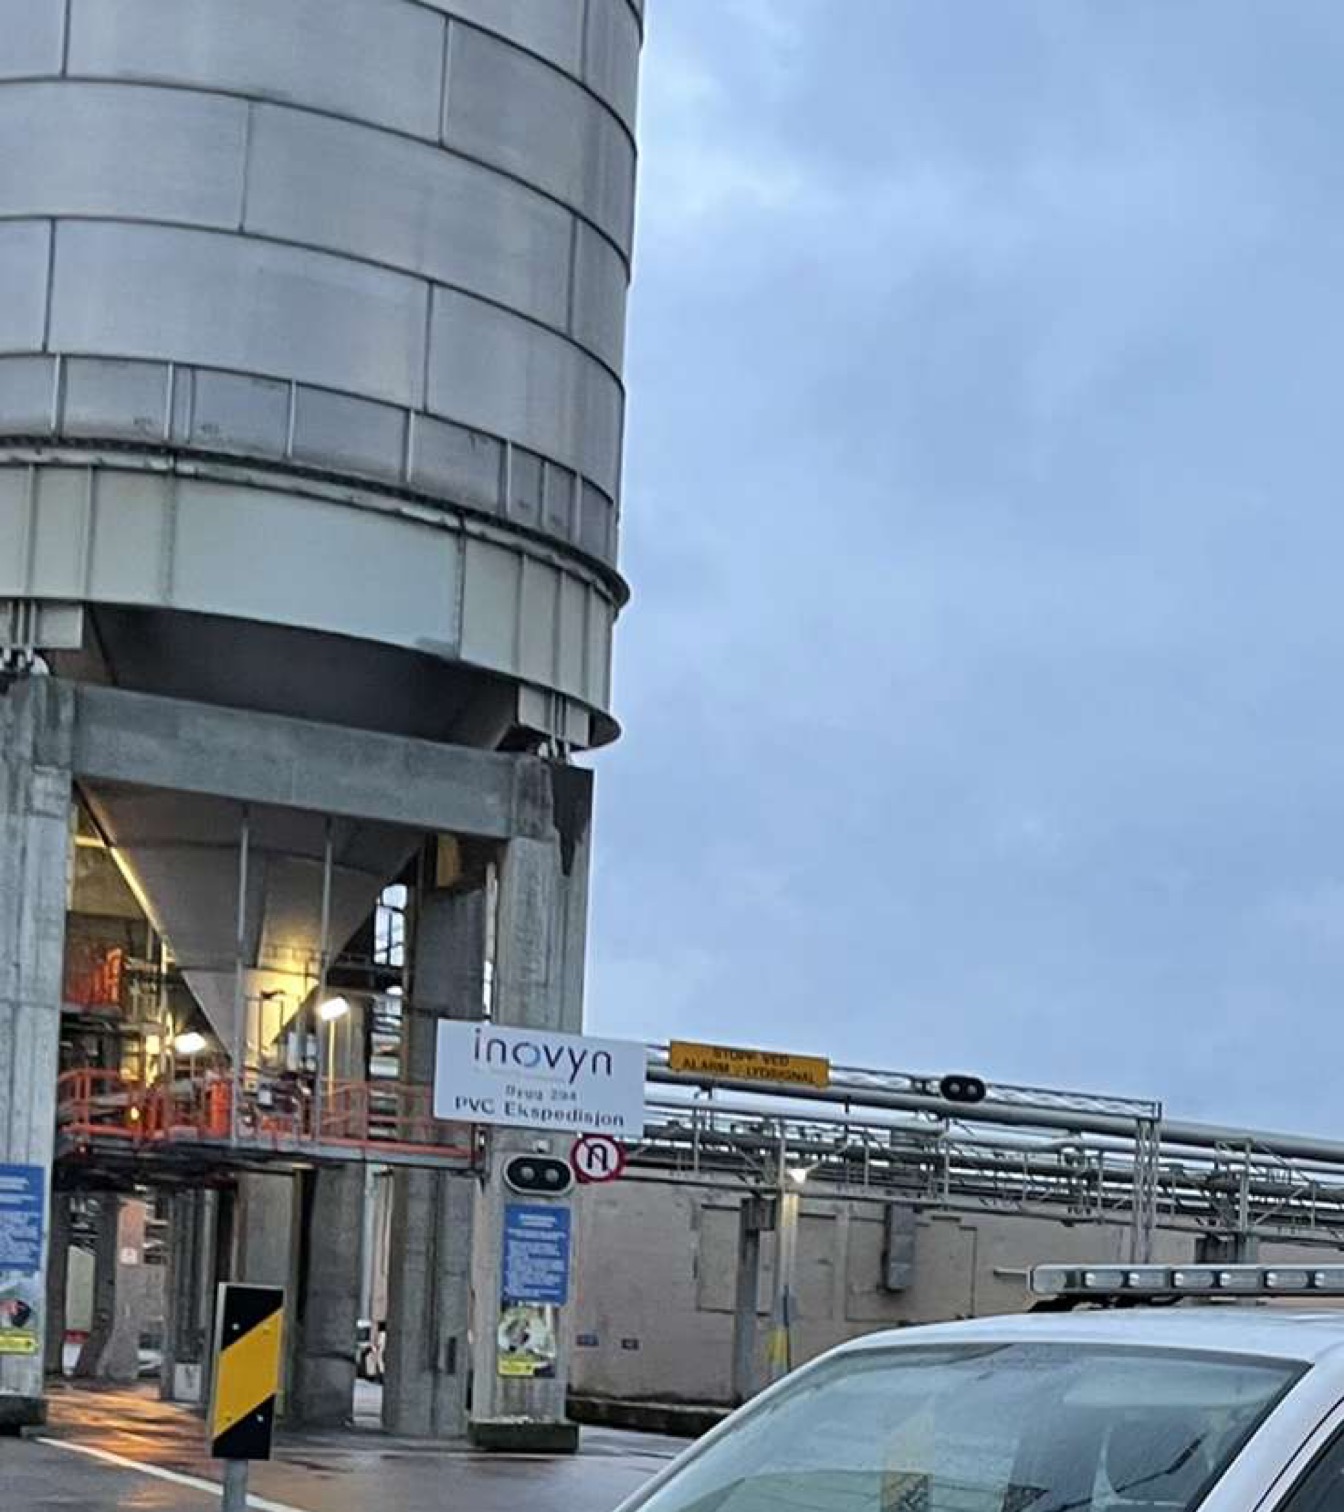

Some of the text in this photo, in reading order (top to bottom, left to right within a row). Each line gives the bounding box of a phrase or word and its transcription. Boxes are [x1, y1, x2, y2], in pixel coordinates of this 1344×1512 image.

[474, 1027, 612, 1084] inovyn
[455, 1096, 625, 1128] PVC Ekspedisjon
